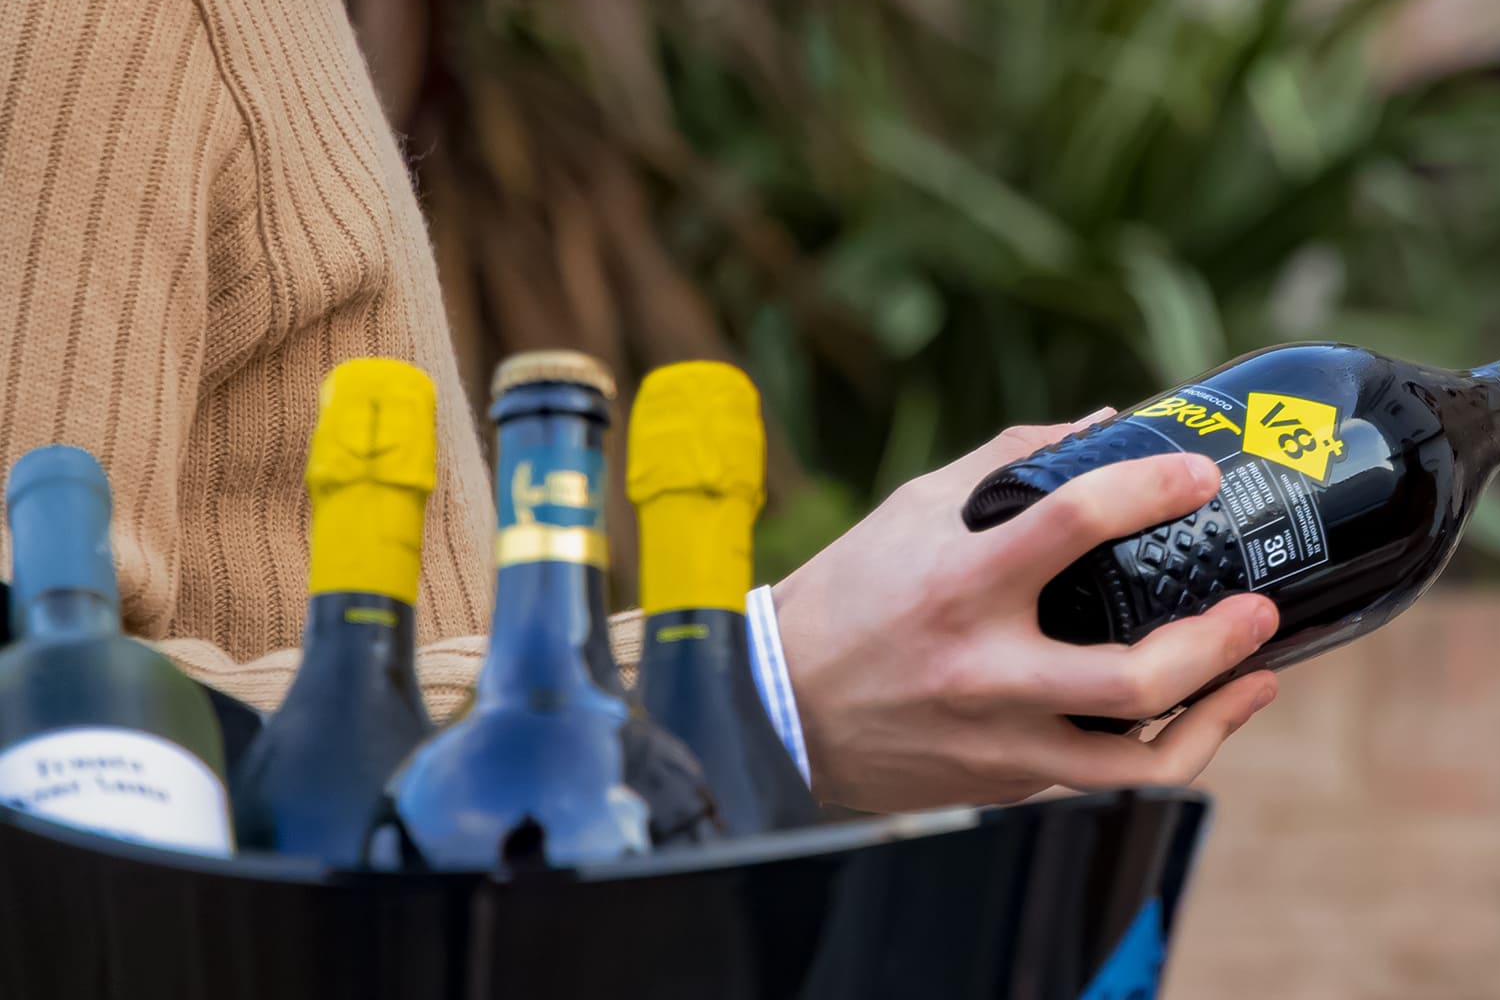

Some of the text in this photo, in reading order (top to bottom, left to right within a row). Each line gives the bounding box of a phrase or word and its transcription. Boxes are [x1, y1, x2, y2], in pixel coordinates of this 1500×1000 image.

[1133, 397, 1242, 436] BRUT
[1226, 471, 1256, 516] IL METODO
[1236, 466, 1266, 510] SEGUENDO
[1246, 461, 1275, 504] PRODOTTO
[1281, 474, 1314, 558] ORIGINE CONTROLLATA
[1293, 482, 1319, 544] DENOMINAZIONE
[1264, 534, 1287, 568] 30
